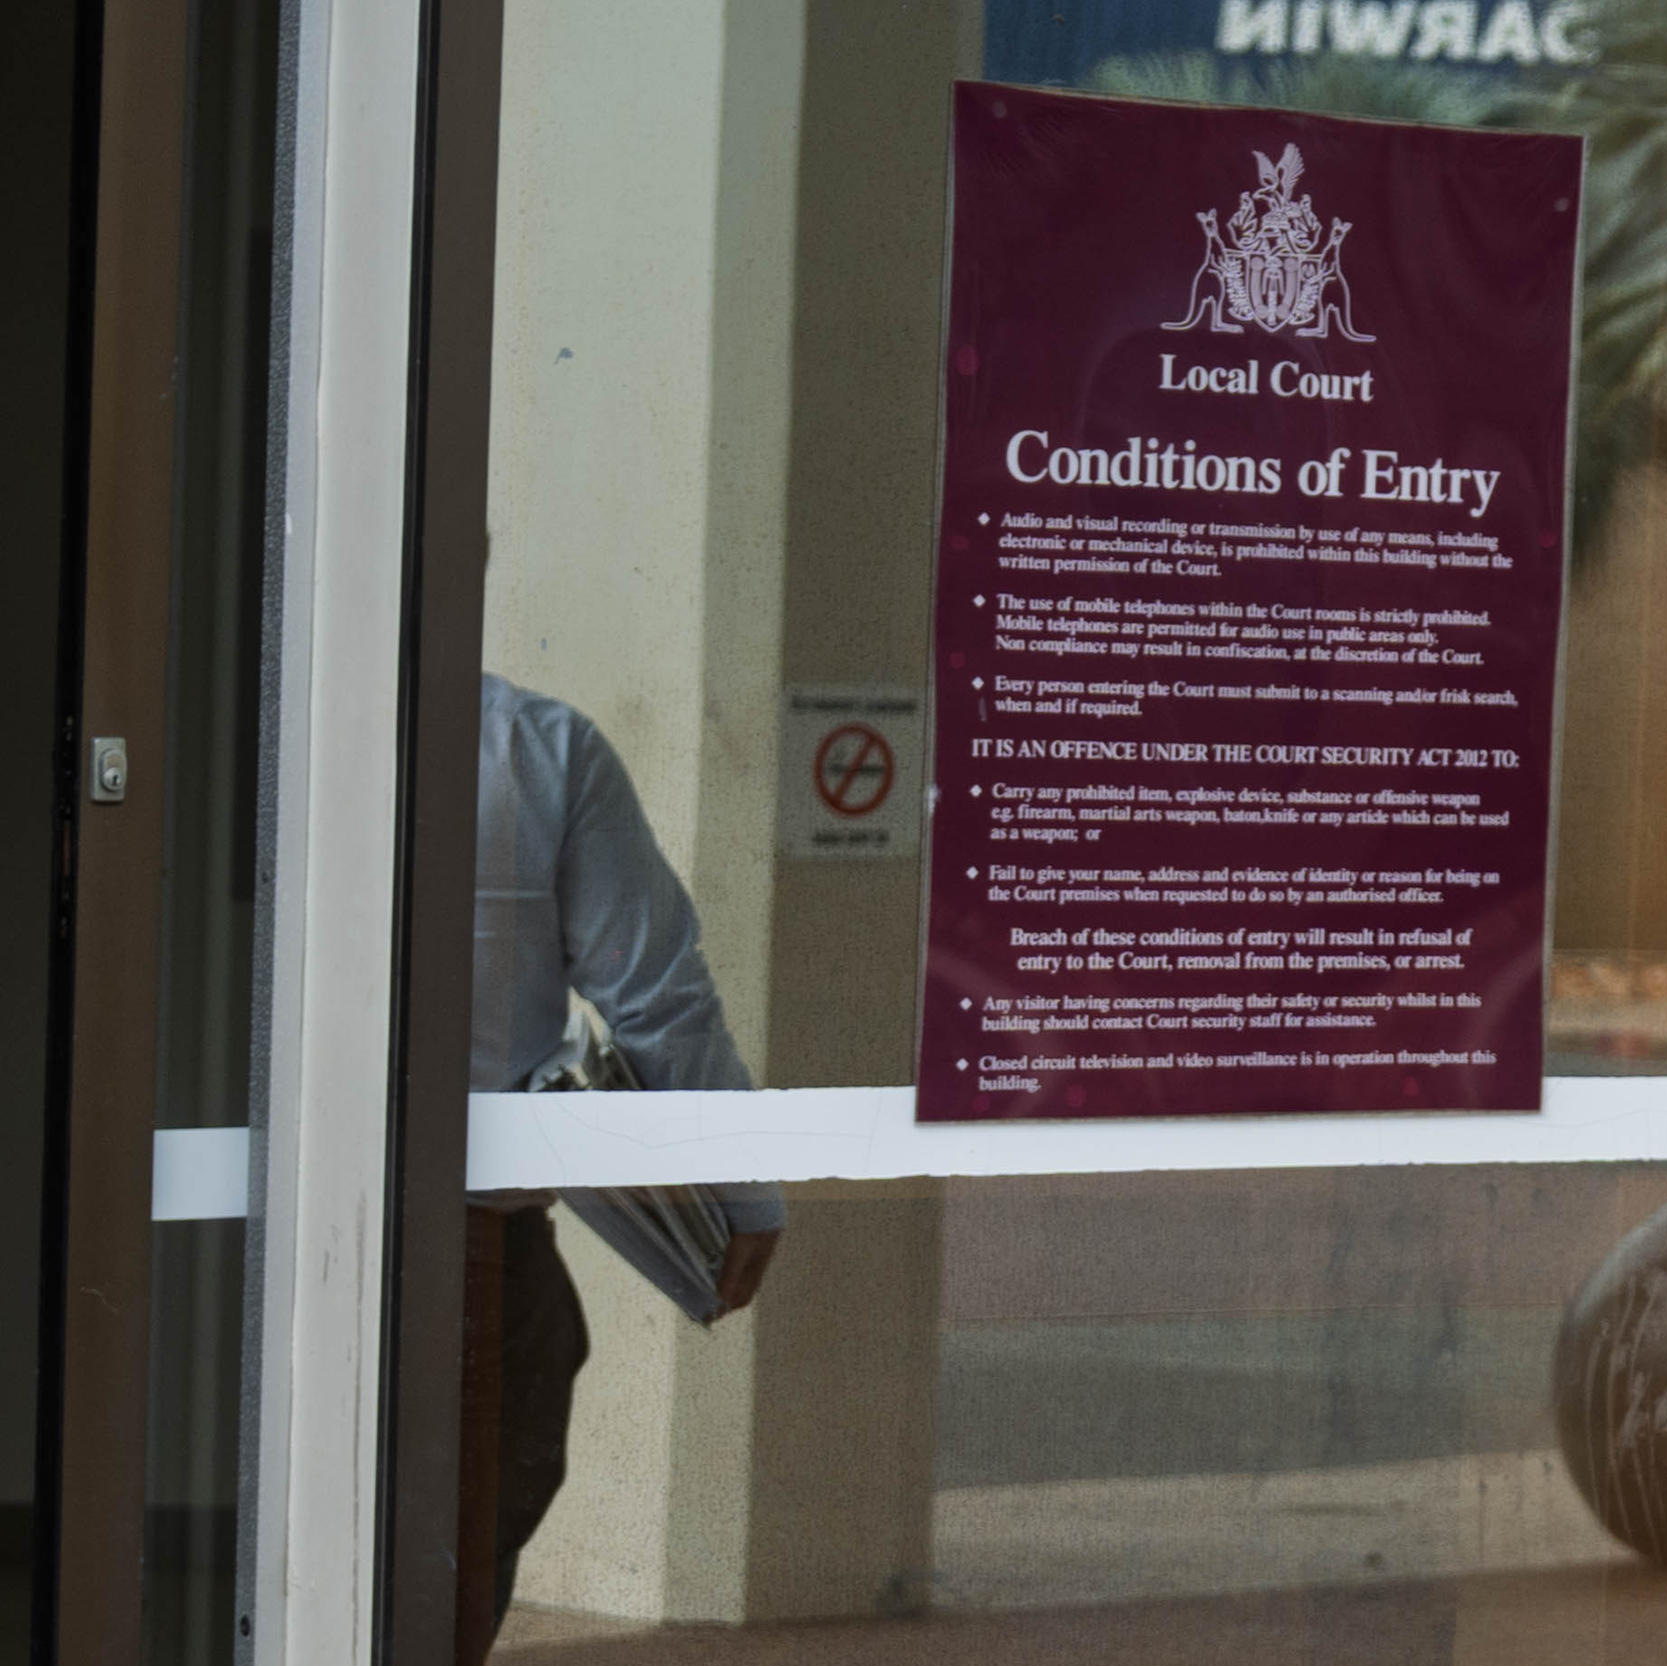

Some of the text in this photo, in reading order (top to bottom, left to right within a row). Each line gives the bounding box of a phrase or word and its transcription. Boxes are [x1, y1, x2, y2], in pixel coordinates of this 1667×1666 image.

[1160, 354, 1373, 402] Local Court
[1007, 430, 1500, 517] Conditions of Entry
[1001, 513, 1498, 552] Audio and visual recording or transmission by use of any means, including
[999, 555, 1221, 576] written permission of the Court.
[997, 594, 1490, 627] The use of mobile telephones within the Court rooms is strictly prohibited.
[995, 675, 1034, 695] Every
[1038, 681, 1084, 696] person
[1087, 680, 1145, 699] entering
[1148, 681, 1170, 696] the
[1173, 681, 1214, 697] Court
[1218, 686, 1252, 698] must
[1255, 684, 1300, 699] submit
[1304, 688, 1318, 700] to
[1320, 689, 1330, 700] a
[1332, 687, 1393, 705] scanning
[1440, 688, 1471, 704] frisk
[1474, 690, 1518, 706] search,
[995, 698, 1142, 718] when and if required.
[972, 739, 1519, 767] IT IS AN OFFENCE UNDER THE COURT SECURITY ACT 2012 TO:
[1011, 928, 1471, 949] Breach of these conditions of entry will result in refusal of
[1017, 951, 1464, 974] entry to the Court, removal from the premises, or arrest.
[984, 993, 1481, 1016] Any visitor having concerns regarding their safety or security whilst in this
[982, 1012, 1376, 1034] building should contact Court security staff for assistance.
